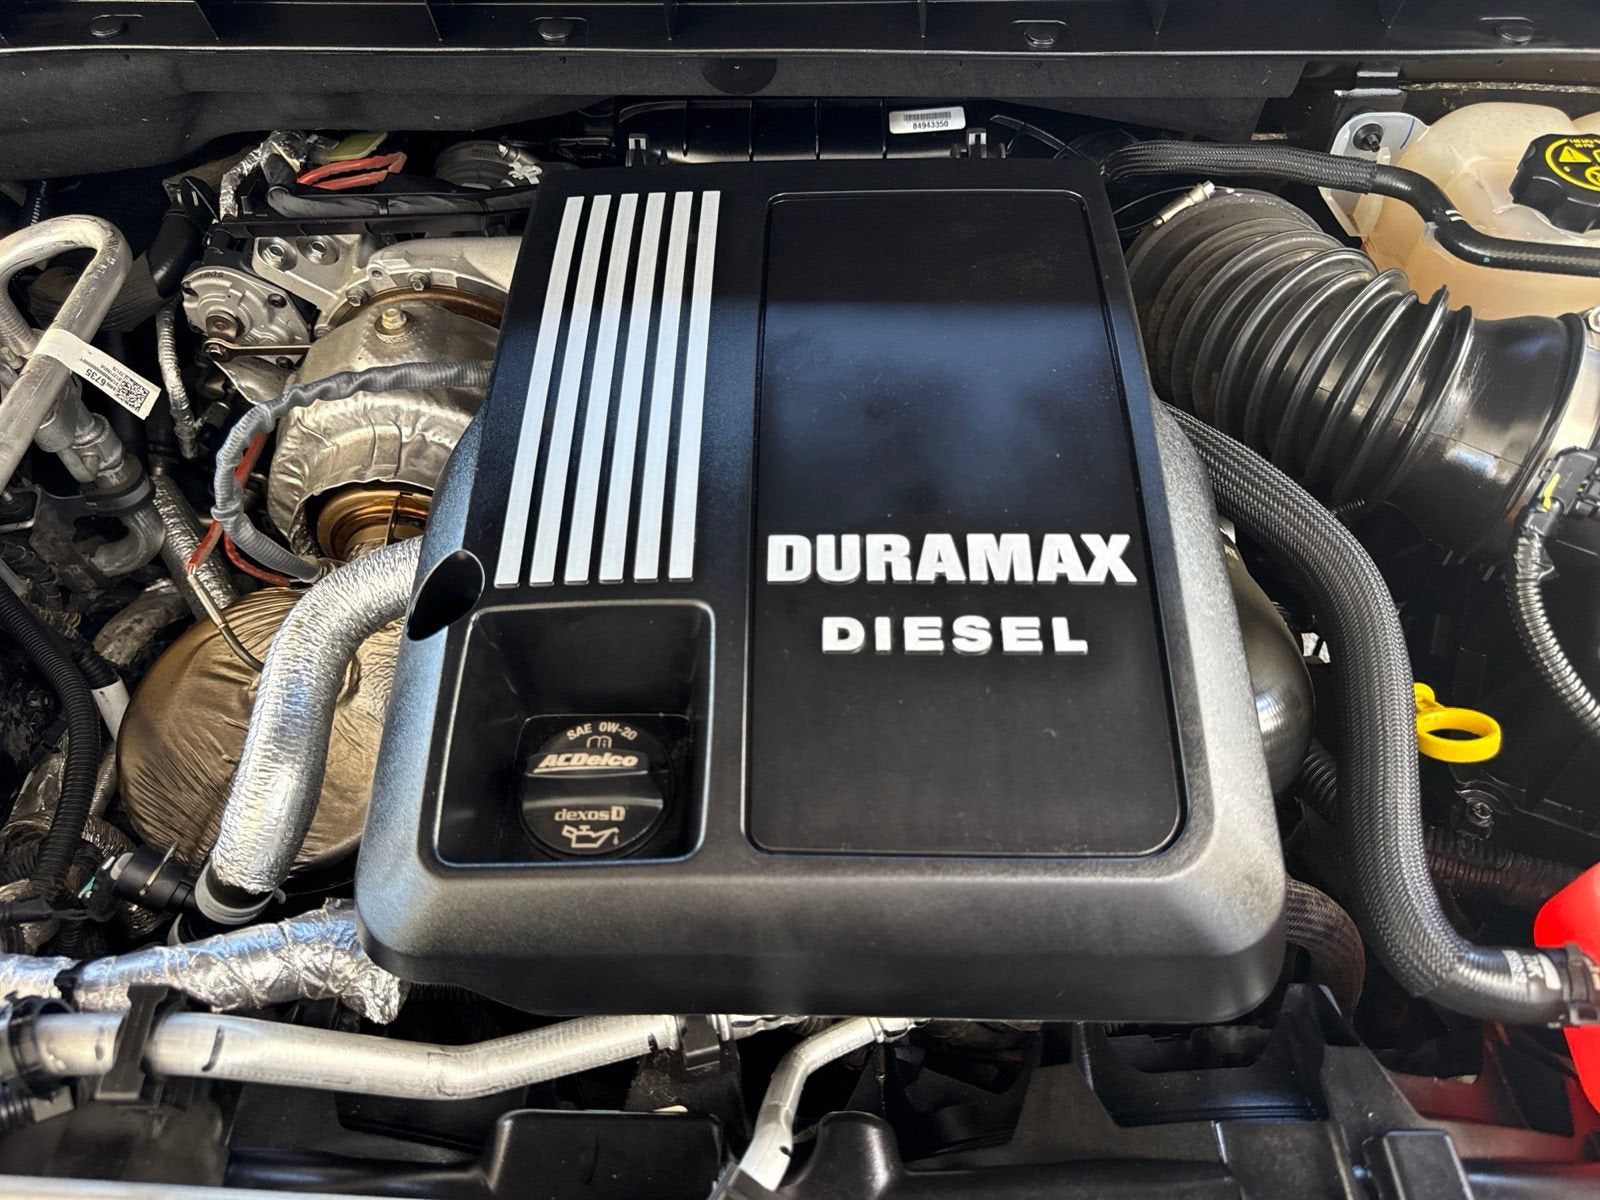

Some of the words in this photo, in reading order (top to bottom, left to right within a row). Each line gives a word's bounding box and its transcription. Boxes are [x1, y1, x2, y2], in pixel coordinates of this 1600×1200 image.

[912, 120, 949, 130] 84943350
[767, 533, 1138, 584] DURAMAX
[821, 615, 1089, 655] DIESEL
[566, 723, 593, 741] SAE
[599, 721, 638, 741] 0W-20
[538, 752, 639, 768] ACDelco
